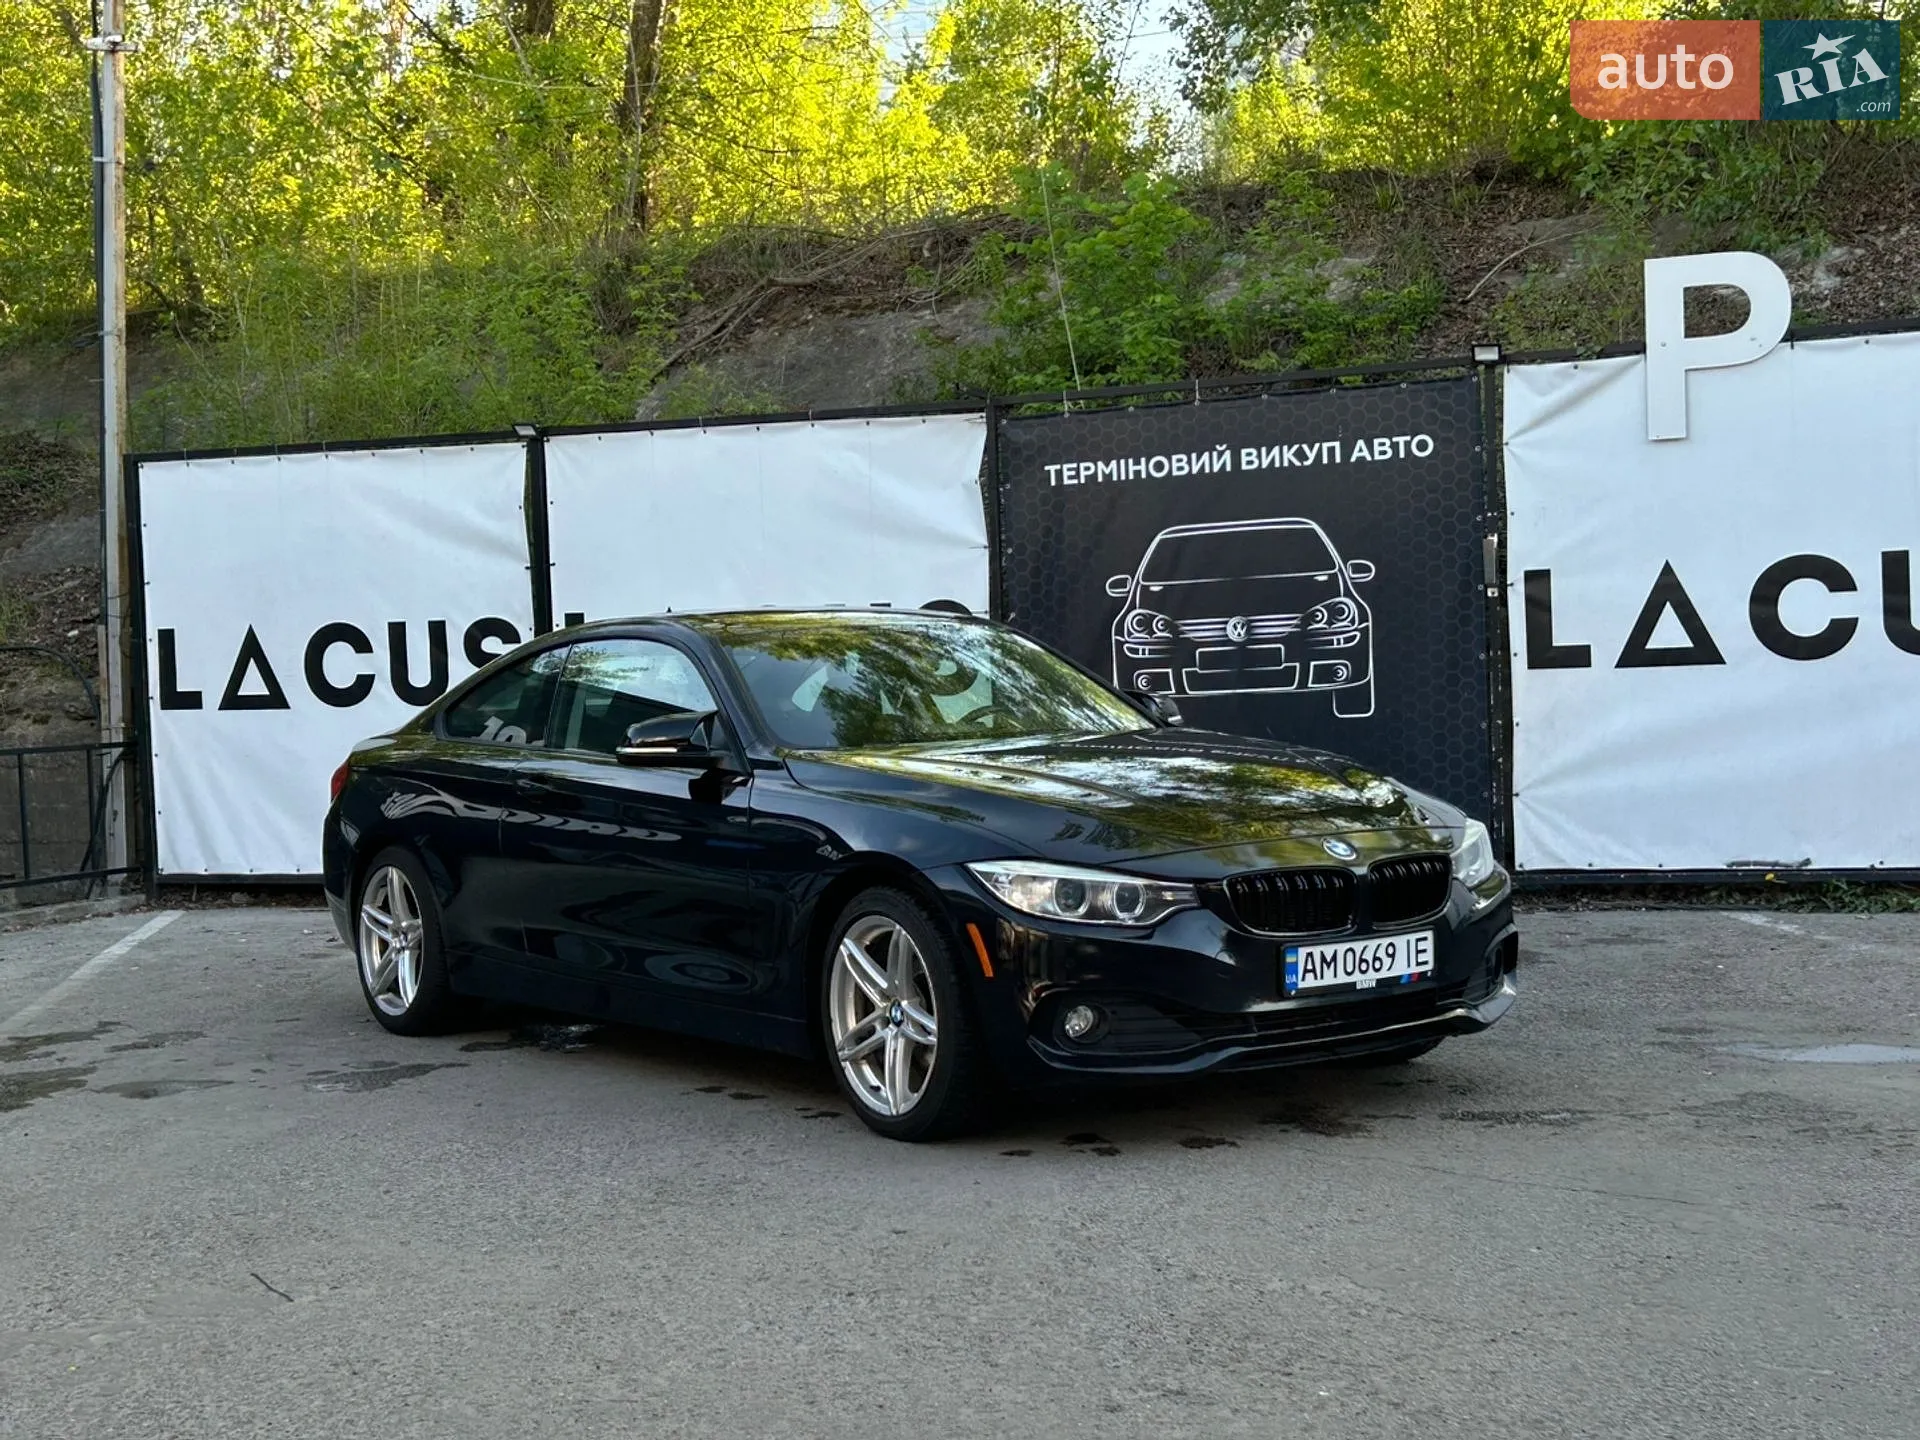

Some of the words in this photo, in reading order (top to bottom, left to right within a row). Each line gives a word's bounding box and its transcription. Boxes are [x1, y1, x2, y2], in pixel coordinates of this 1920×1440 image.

[1644, 251, 1792, 441] P
[1044, 445, 1232, 486] ТЕРМІНОВИЙ
[1240, 441, 1341, 470] ВИКУП
[1350, 434, 1434, 463] АВТО
